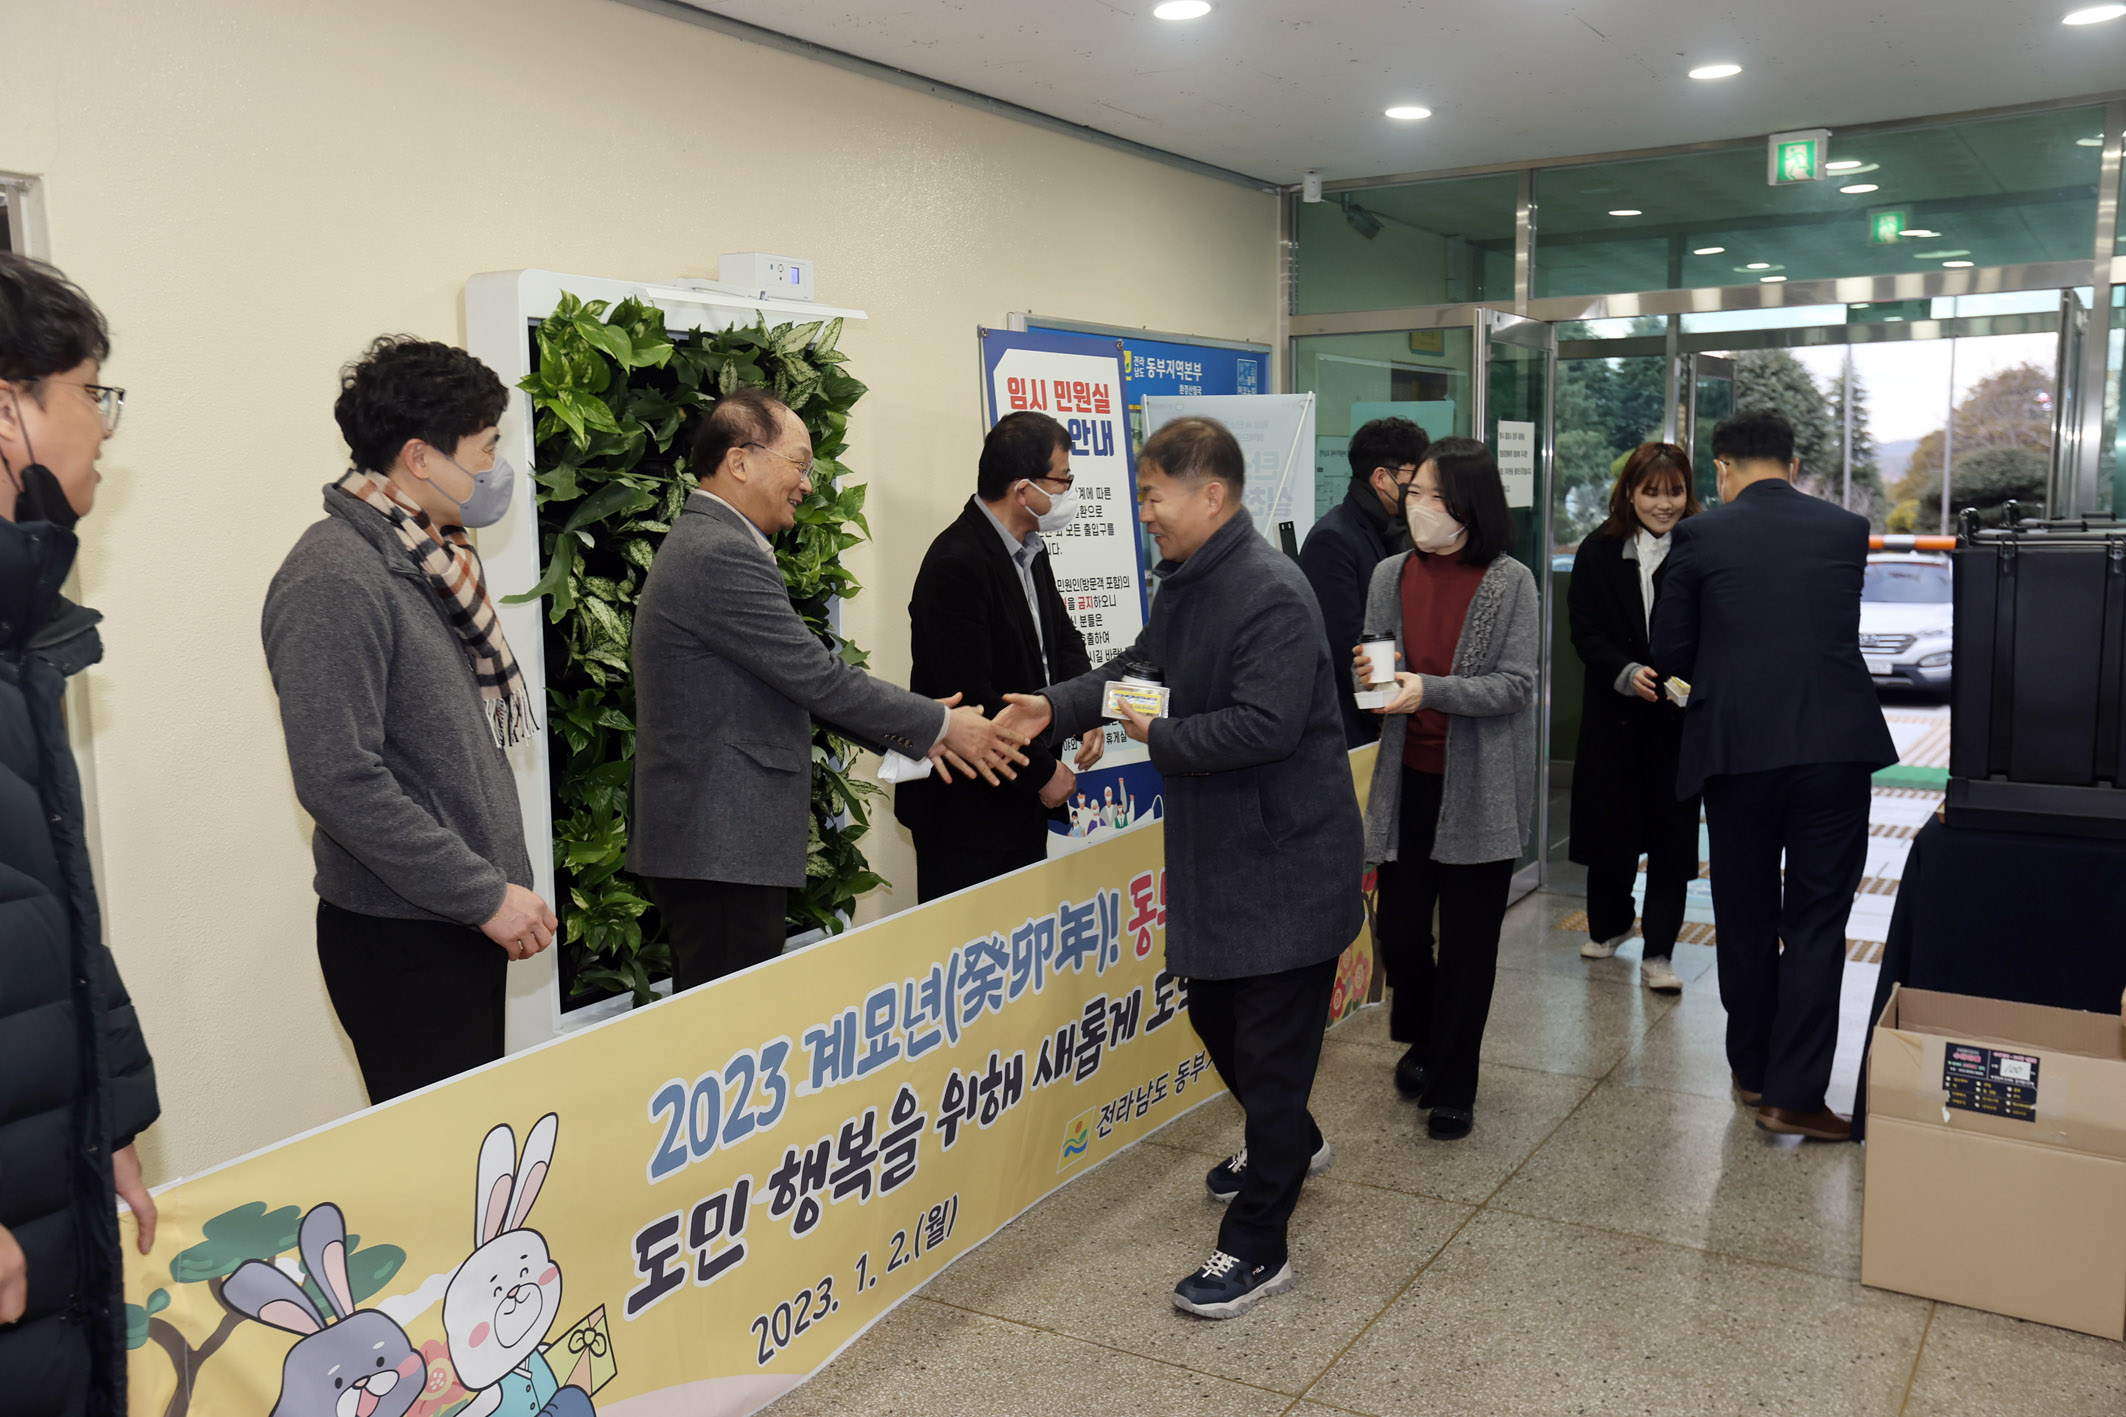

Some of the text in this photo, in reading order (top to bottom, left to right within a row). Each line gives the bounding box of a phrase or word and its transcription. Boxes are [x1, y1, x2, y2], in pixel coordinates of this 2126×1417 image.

[1146, 357, 1202, 382] 동부지역본부
[1007, 377, 1111, 414] 임시 민원실
[1068, 418, 1114, 456] 안내
[1075, 487, 1112, 500] 계에 따른
[1075, 505, 1103, 518] 환으로
[1084, 523, 1115, 537] 출입구를
[1106, 575, 1130, 590] 포함)의
[1078, 594, 1117, 610] 금지하오니
[1106, 731, 1127, 745] 휴게실
[650, 1041, 790, 1180] 2023
[804, 891, 1119, 1089] 계묘년(癸卯年)!
[1096, 1072, 1169, 1139] 전라남도
[627, 1179, 750, 1316] 도민
[768, 1088, 925, 1235] 행복을
[936, 1054, 1023, 1147] 위해
[1032, 989, 1142, 1087] 새롭게
[751, 1277, 839, 1365] 2023.
[855, 1252, 877, 1292] 1.
